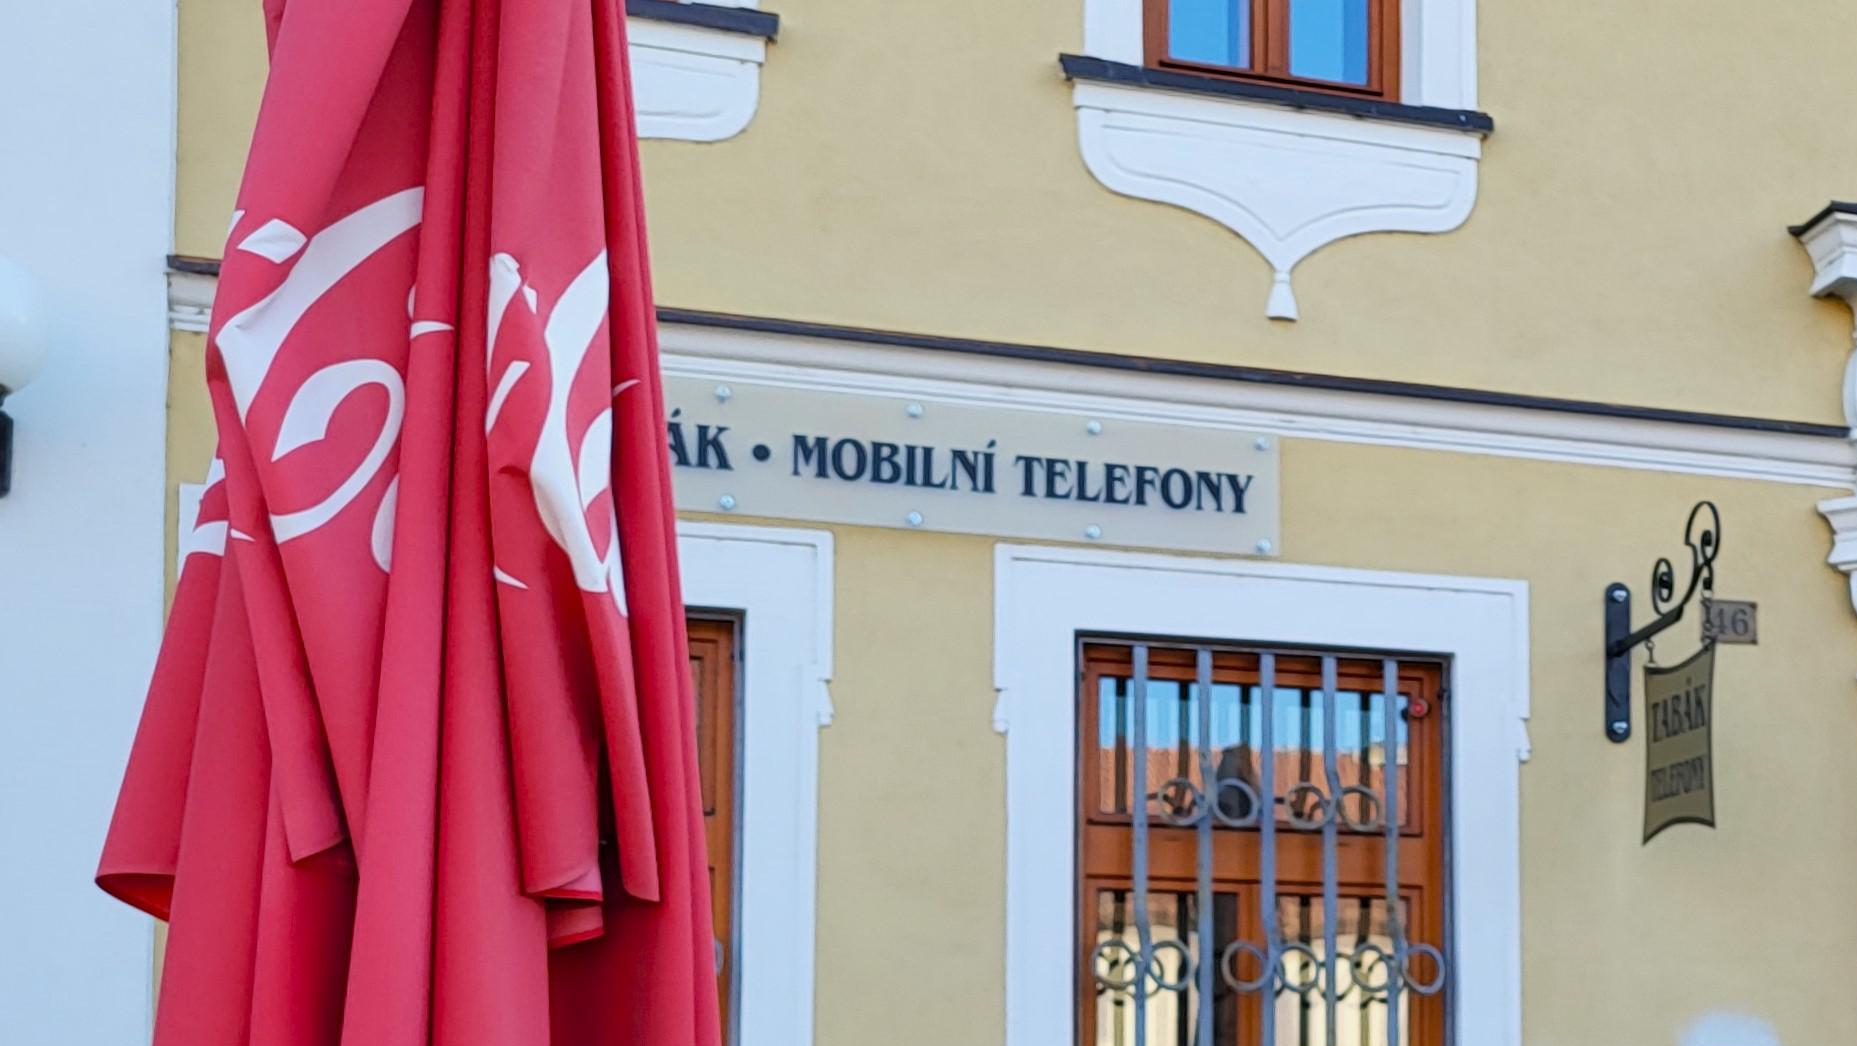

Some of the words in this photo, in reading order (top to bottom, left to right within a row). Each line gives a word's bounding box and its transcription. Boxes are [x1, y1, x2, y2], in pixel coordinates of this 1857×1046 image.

[792, 434, 997, 494] MOBILNÍ
[1015, 454, 1254, 514] TELEFONY
[1652, 676, 1706, 743] TABÁK
